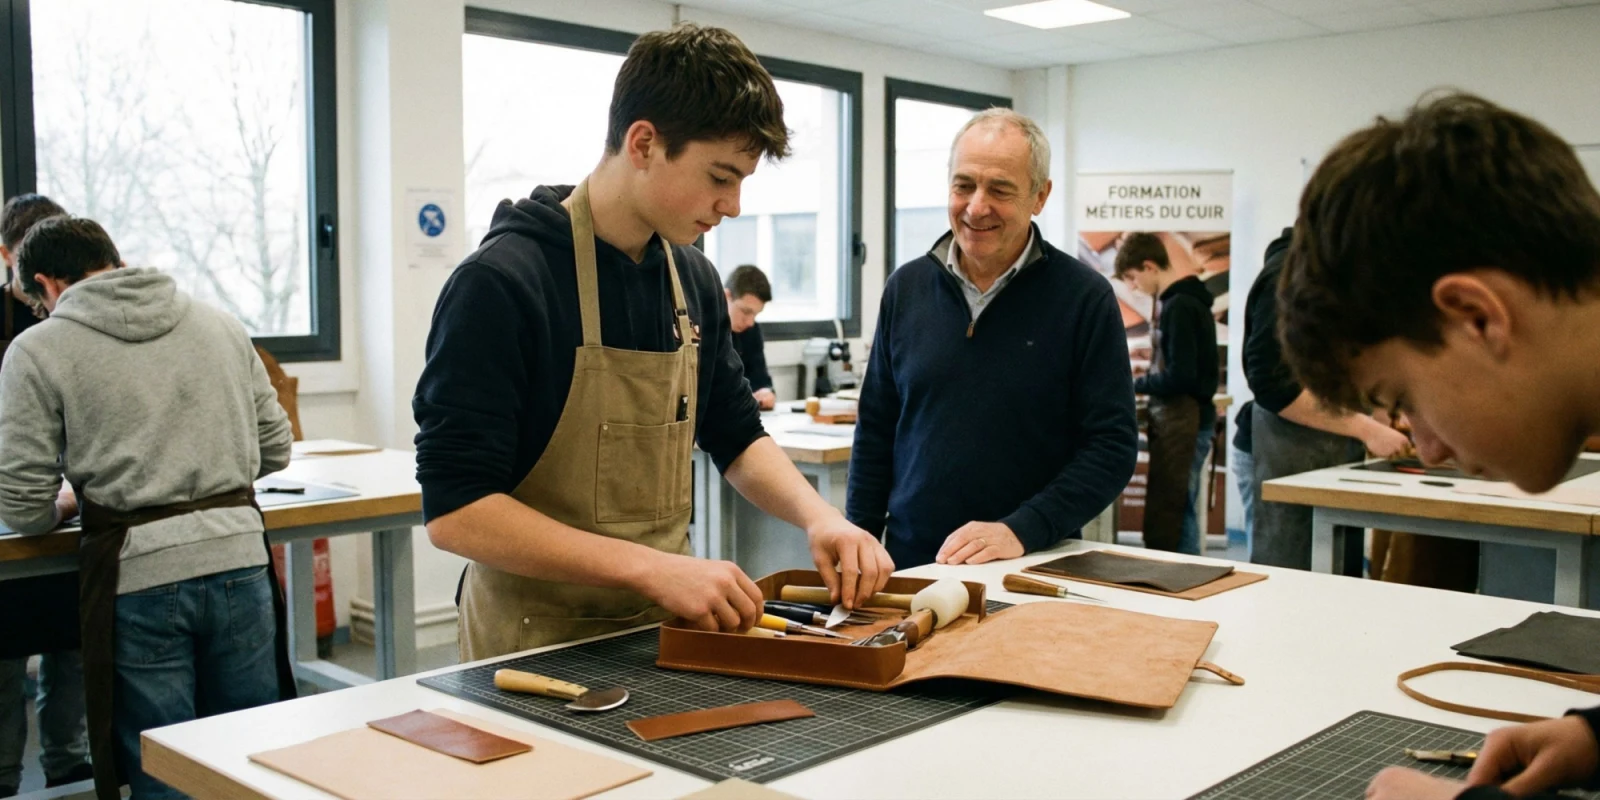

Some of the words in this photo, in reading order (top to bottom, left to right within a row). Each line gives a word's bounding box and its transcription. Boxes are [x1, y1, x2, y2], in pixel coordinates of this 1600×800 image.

[1108, 185, 1201, 199] FORMATION
[1086, 202, 1155, 219] MÉTIERS
[1160, 205, 1181, 219] DU
[1186, 204, 1224, 219] CUIR
